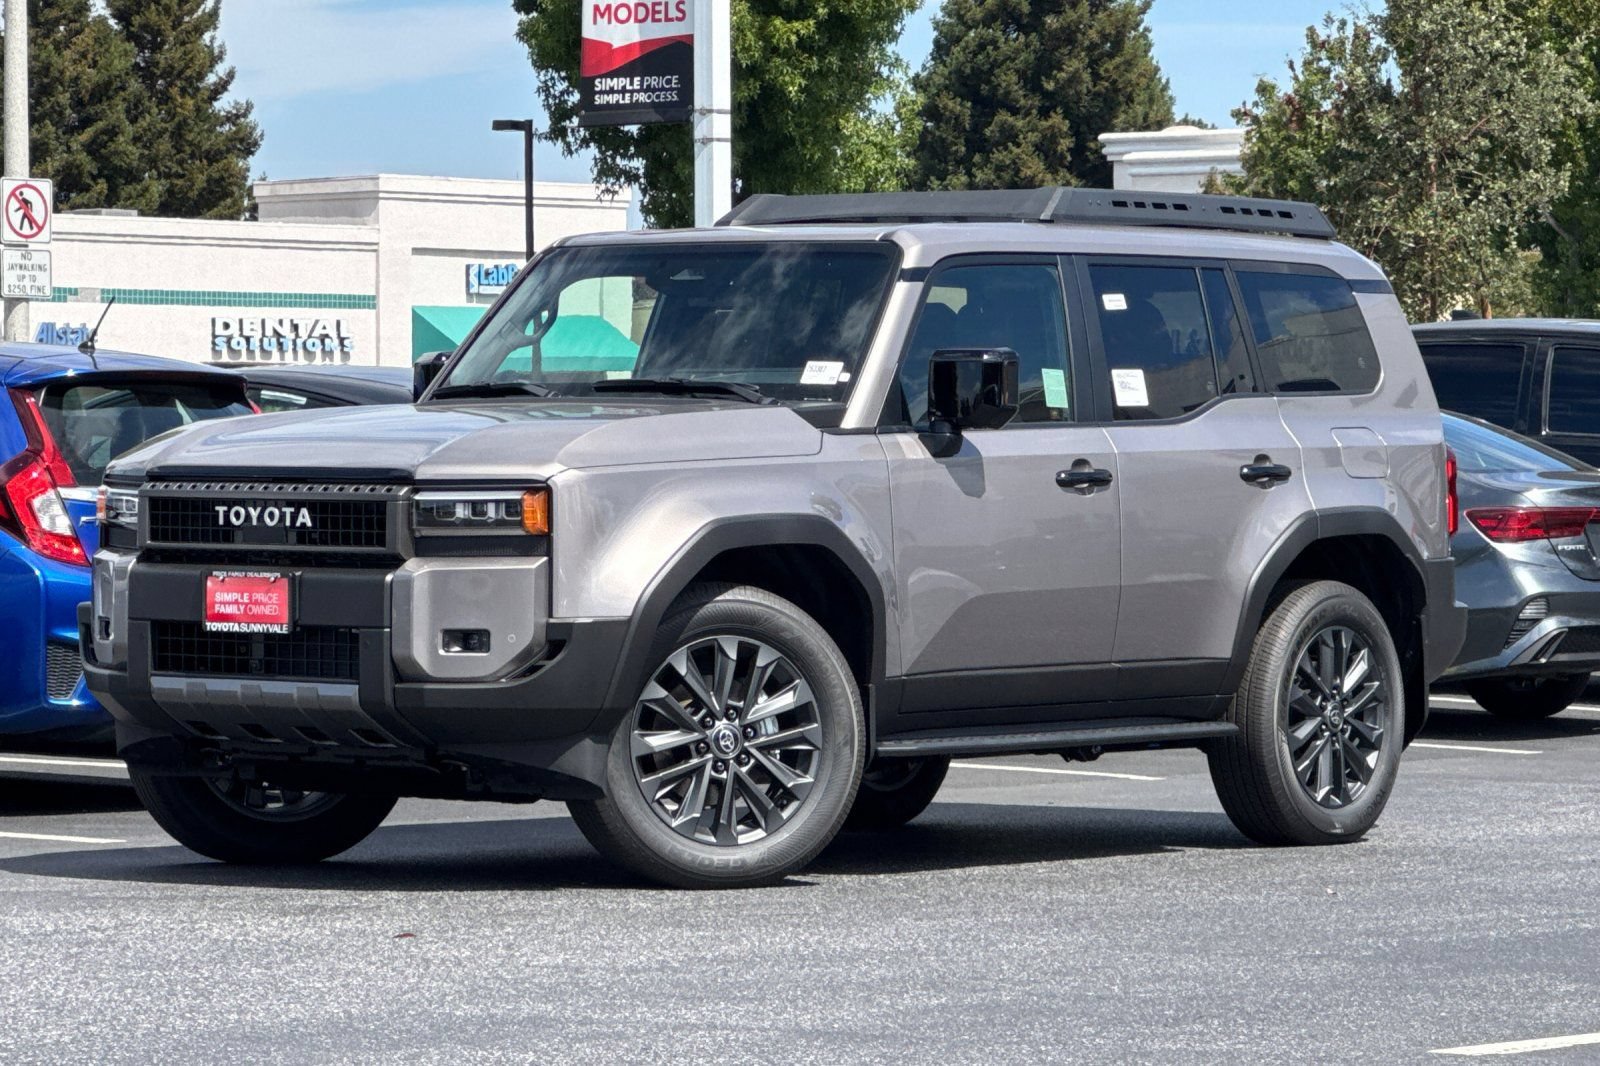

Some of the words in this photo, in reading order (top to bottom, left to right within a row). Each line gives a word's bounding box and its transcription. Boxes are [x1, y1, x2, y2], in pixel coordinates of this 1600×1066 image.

[592, 0, 687, 25] MODELS
[594, 77, 641, 91] SIMPLE
[643, 75, 681, 89] PRICE.
[594, 93, 631, 105] SIMPLE
[632, 91, 679, 103] PROCESS.
[20, 251, 32, 261] NO
[8, 263, 47, 272] JAYWALKING
[17, 274, 26, 282] UP
[29, 274, 37, 283] TO
[8, 284, 26, 293] $250
[30, 285, 46, 294] FINE
[33, 321, 97, 345] Allstat
[211, 317, 350, 337] DENTAL
[213, 336, 354, 352] SOLUTIONS
[214, 505, 312, 527] TOYOTA
[214, 592, 250, 602] SIMPLE
[214, 604, 245, 614] FAMILY
